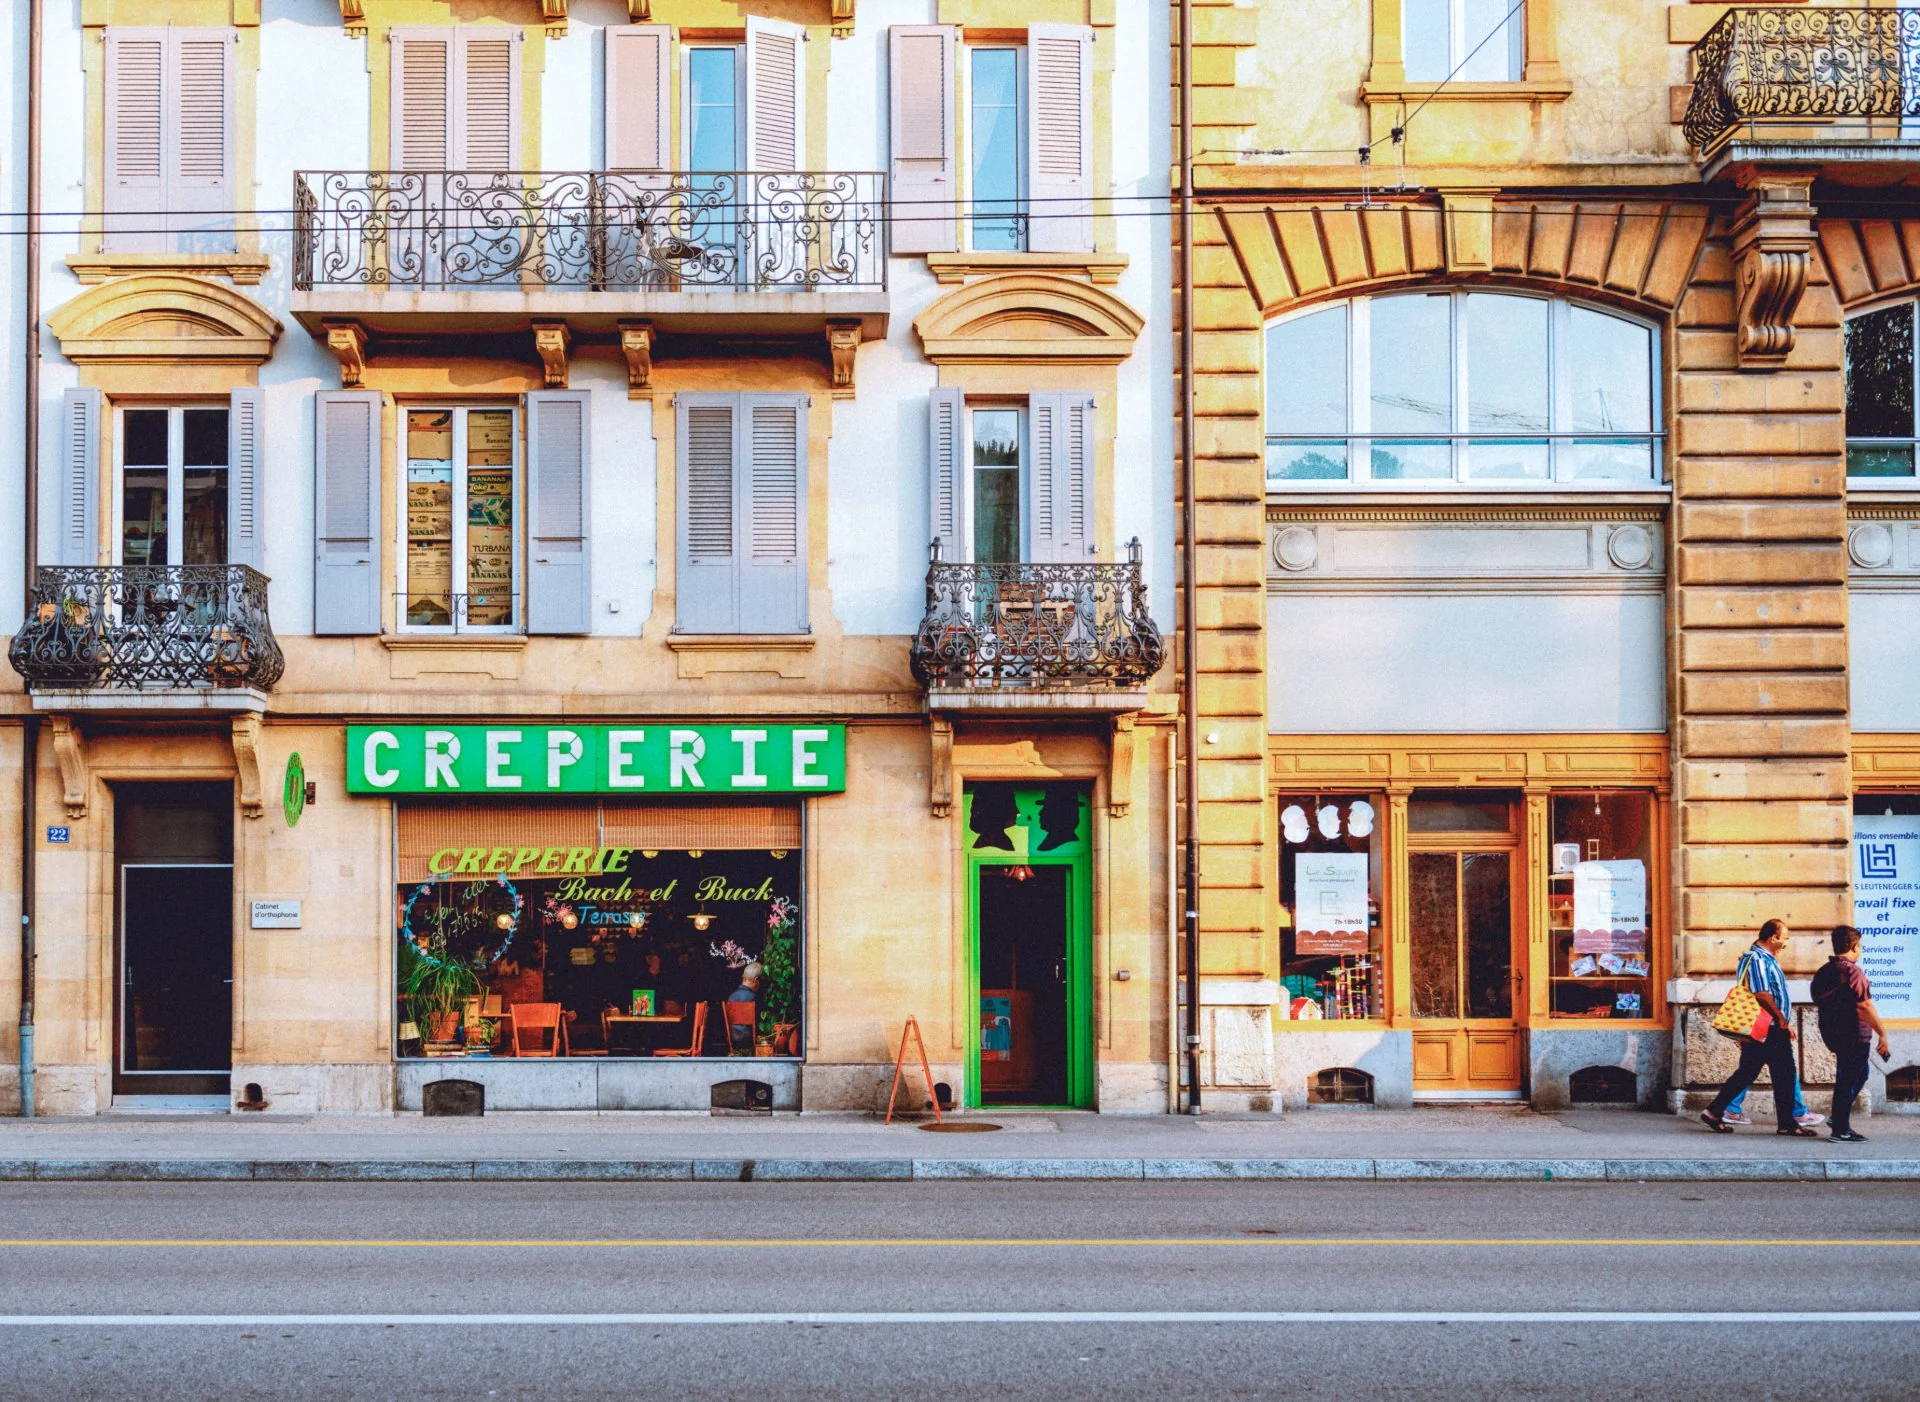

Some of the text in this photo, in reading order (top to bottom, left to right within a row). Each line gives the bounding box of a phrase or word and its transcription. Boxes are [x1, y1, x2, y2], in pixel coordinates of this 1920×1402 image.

[472, 545, 511, 553] TURBANA
[470, 571, 507, 579] BANANAS
[363, 730, 829, 788] CREPERIE
[50, 828, 66, 841] 22
[429, 847, 634, 874] CREPERIE
[555, 876, 773, 901] Bach et Buck
[1892, 898, 1916, 908] fixe
[1877, 912, 1890, 921] et
[1863, 958, 1896, 966] Montage
